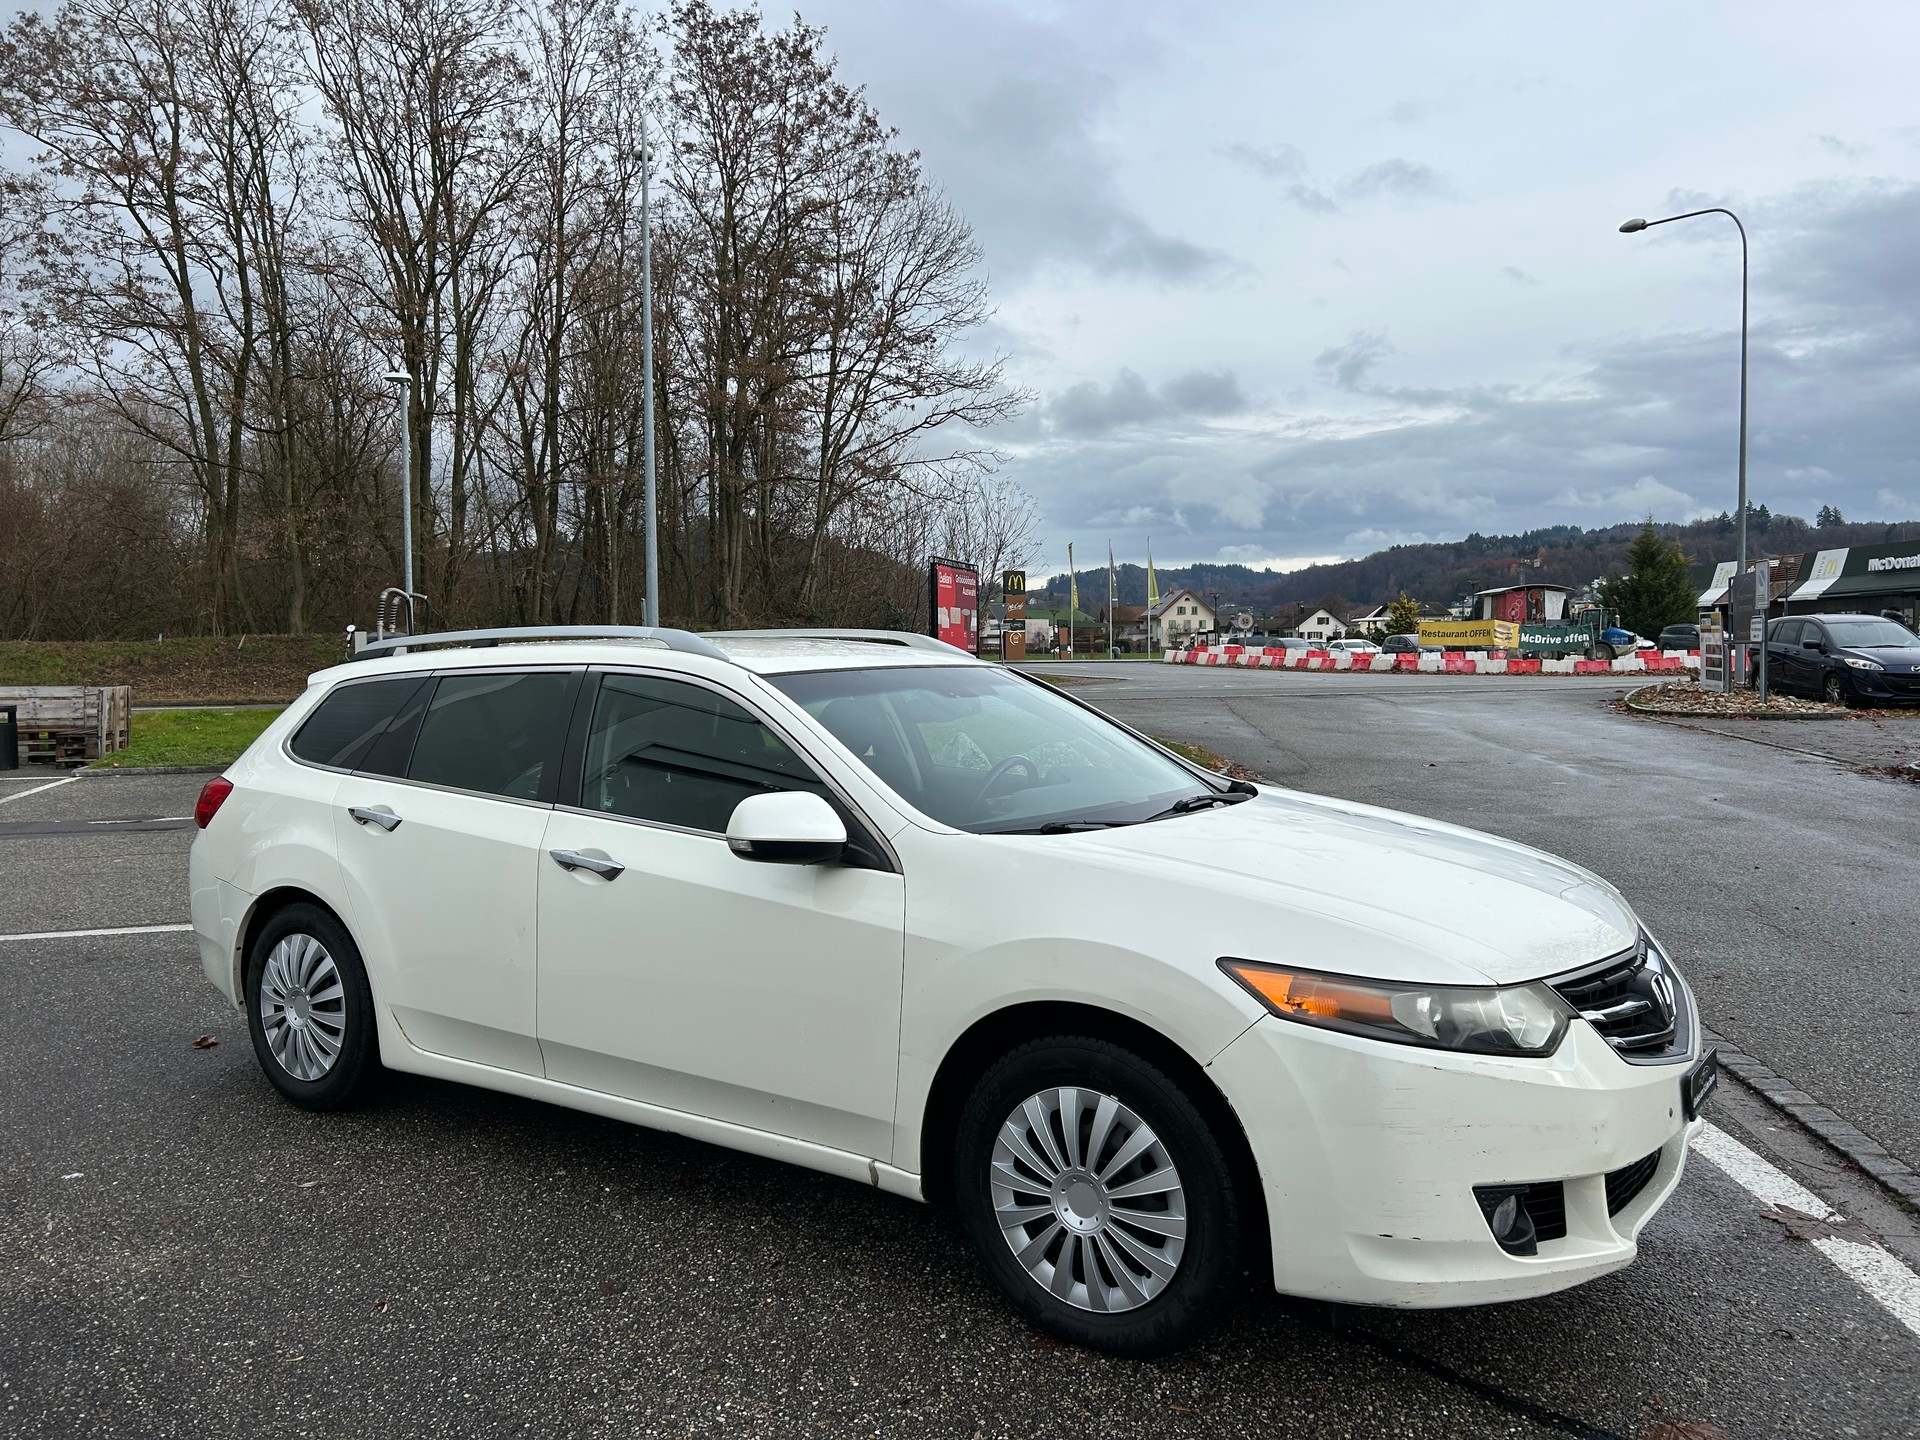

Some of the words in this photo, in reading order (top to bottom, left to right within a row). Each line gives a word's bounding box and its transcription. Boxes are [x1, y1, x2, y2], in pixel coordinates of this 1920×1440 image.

[1421, 629, 1468, 638] Restaurant
[1470, 628, 1491, 638] OFFEN
[1521, 632, 1562, 644] McDrive
[1564, 632, 1590, 643] offen
